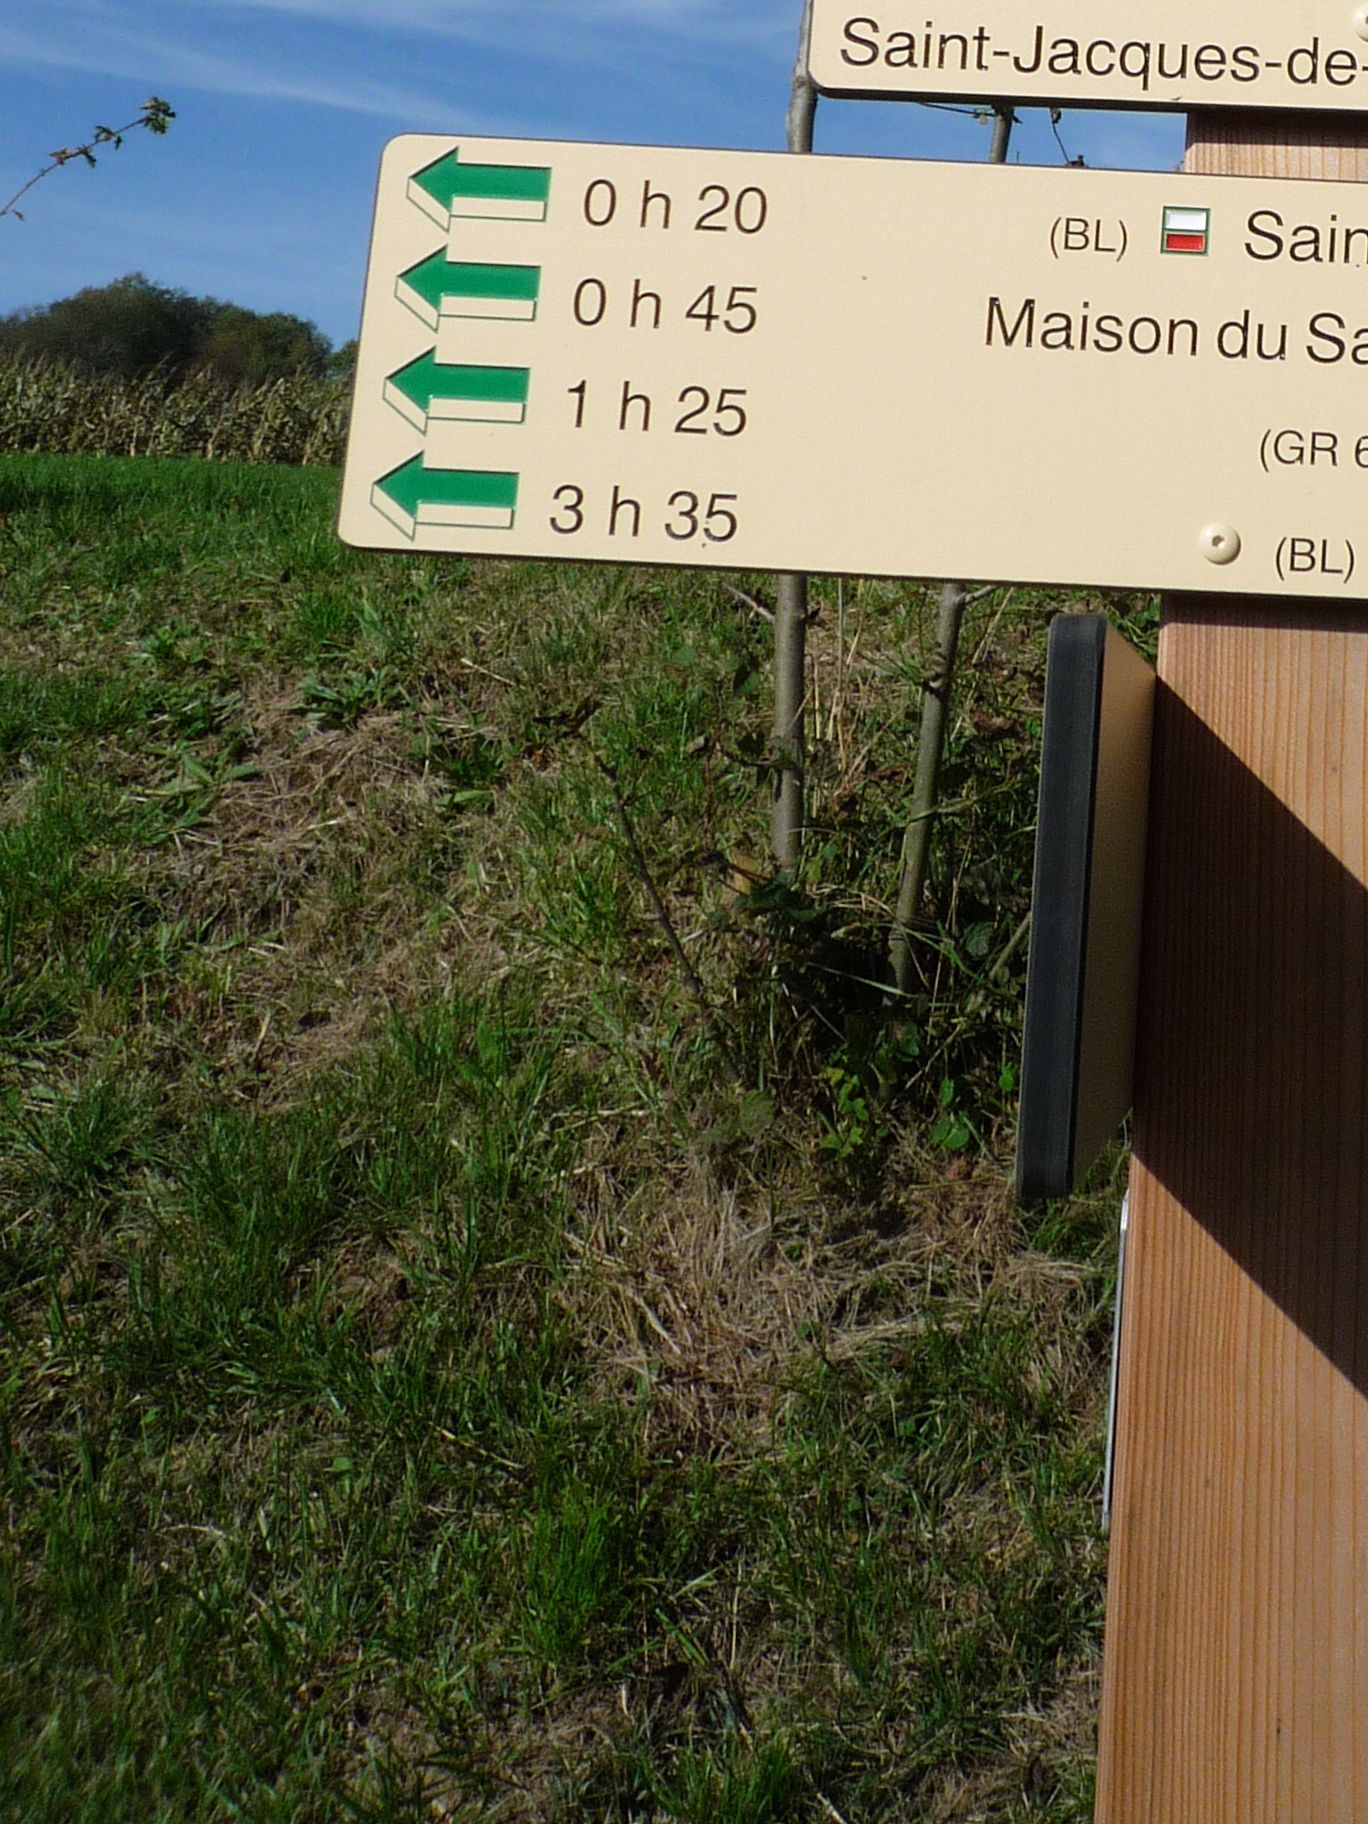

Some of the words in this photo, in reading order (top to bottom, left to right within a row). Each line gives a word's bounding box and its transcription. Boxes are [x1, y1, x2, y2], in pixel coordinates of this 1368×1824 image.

[584, 179, 616, 226] 0
[640, 180, 671, 229] h
[694, 185, 767, 234] 20
[1050, 217, 1127, 262] (BL)
[574, 278, 606, 326] 0
[630, 279, 661, 329] h
[685, 285, 757, 334] 45
[986, 297, 1198, 356] Maison
[1217, 309, 1287, 360] du
[568, 380, 586, 428] 1
[619, 381, 651, 431] h
[674, 386, 747, 437] 25
[1260, 429, 1338, 472] (GR
[550, 485, 583, 534] 3
[609, 485, 640, 537] h
[665, 491, 737, 542] 35
[1276, 537, 1354, 584] (BL)
